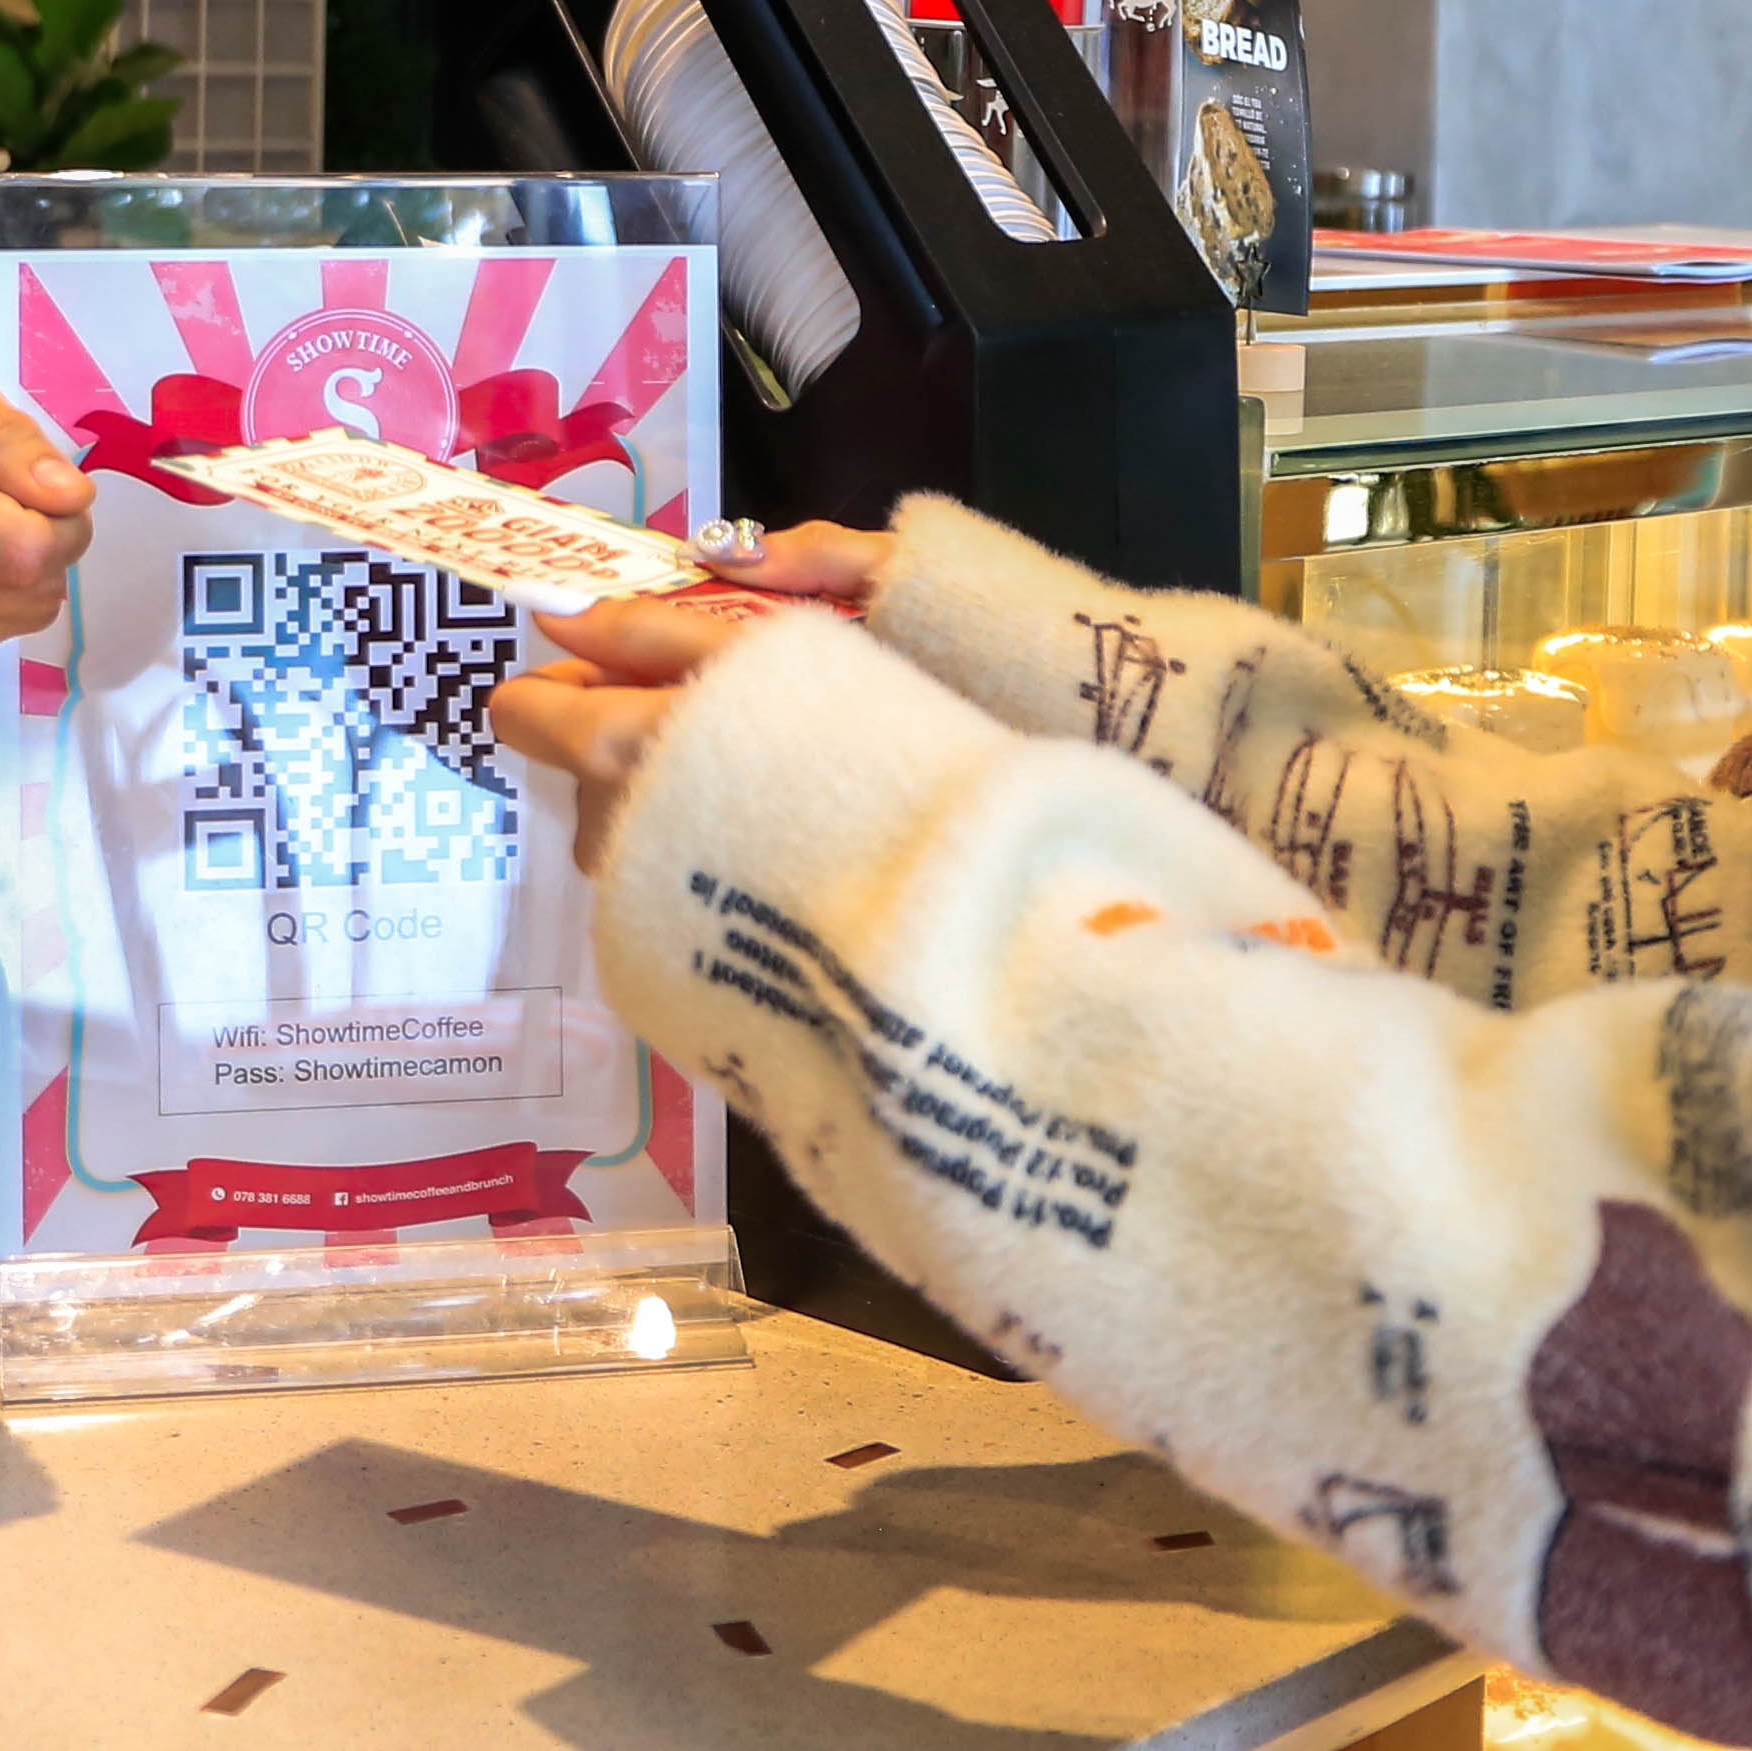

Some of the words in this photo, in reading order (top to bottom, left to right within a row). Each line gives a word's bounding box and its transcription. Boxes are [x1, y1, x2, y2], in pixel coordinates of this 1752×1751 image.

[1200, 18, 1289, 71] BREAD
[285, 330, 414, 374] SHOWTIME
[266, 909, 329, 948] QR
[343, 907, 442, 944] Code
[1499, 921, 1517, 956] OF
[212, 1020, 267, 1050] Wifi:
[276, 1016, 484, 1047] ShowtimeCoffee
[215, 1059, 285, 1087] Pass:
[294, 1051, 503, 1083] Showtimecamon
[233, 1191, 256, 1205] 078
[258, 1191, 280, 1205] 381
[355, 1173, 515, 1206] showtimecoffeeandbrunch
